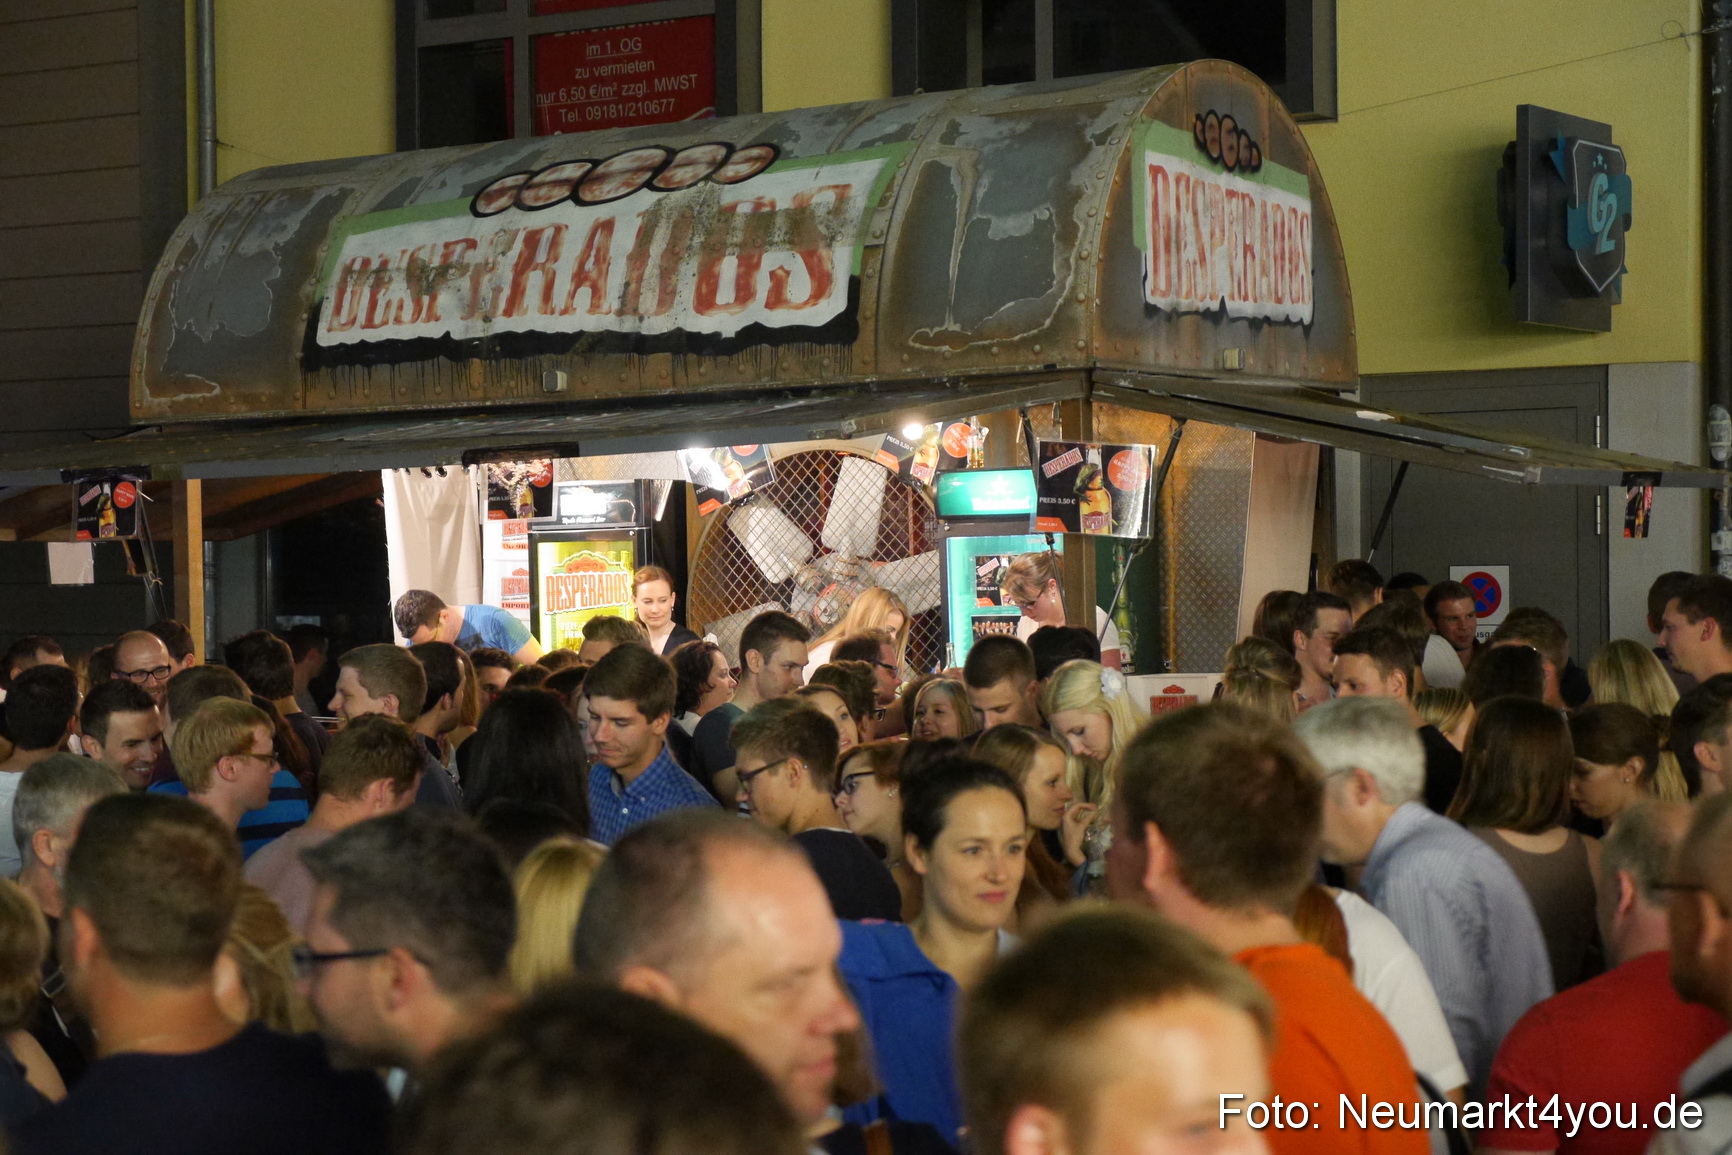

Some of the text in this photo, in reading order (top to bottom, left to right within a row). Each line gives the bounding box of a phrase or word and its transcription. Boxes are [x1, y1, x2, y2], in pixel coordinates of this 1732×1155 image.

[586, 37, 642, 56] im 1. OG
[575, 59, 655, 79] zu vermieten
[536, 91, 557, 104] nur
[559, 86, 586, 103] 6,50
[621, 80, 650, 98] zzgl.
[654, 74, 698, 92] MWST
[559, 98, 675, 123] Tel. 09181/210677
[1148, 163, 1311, 304] DESPERADOS
[545, 573, 629, 612] DESPERADOS
